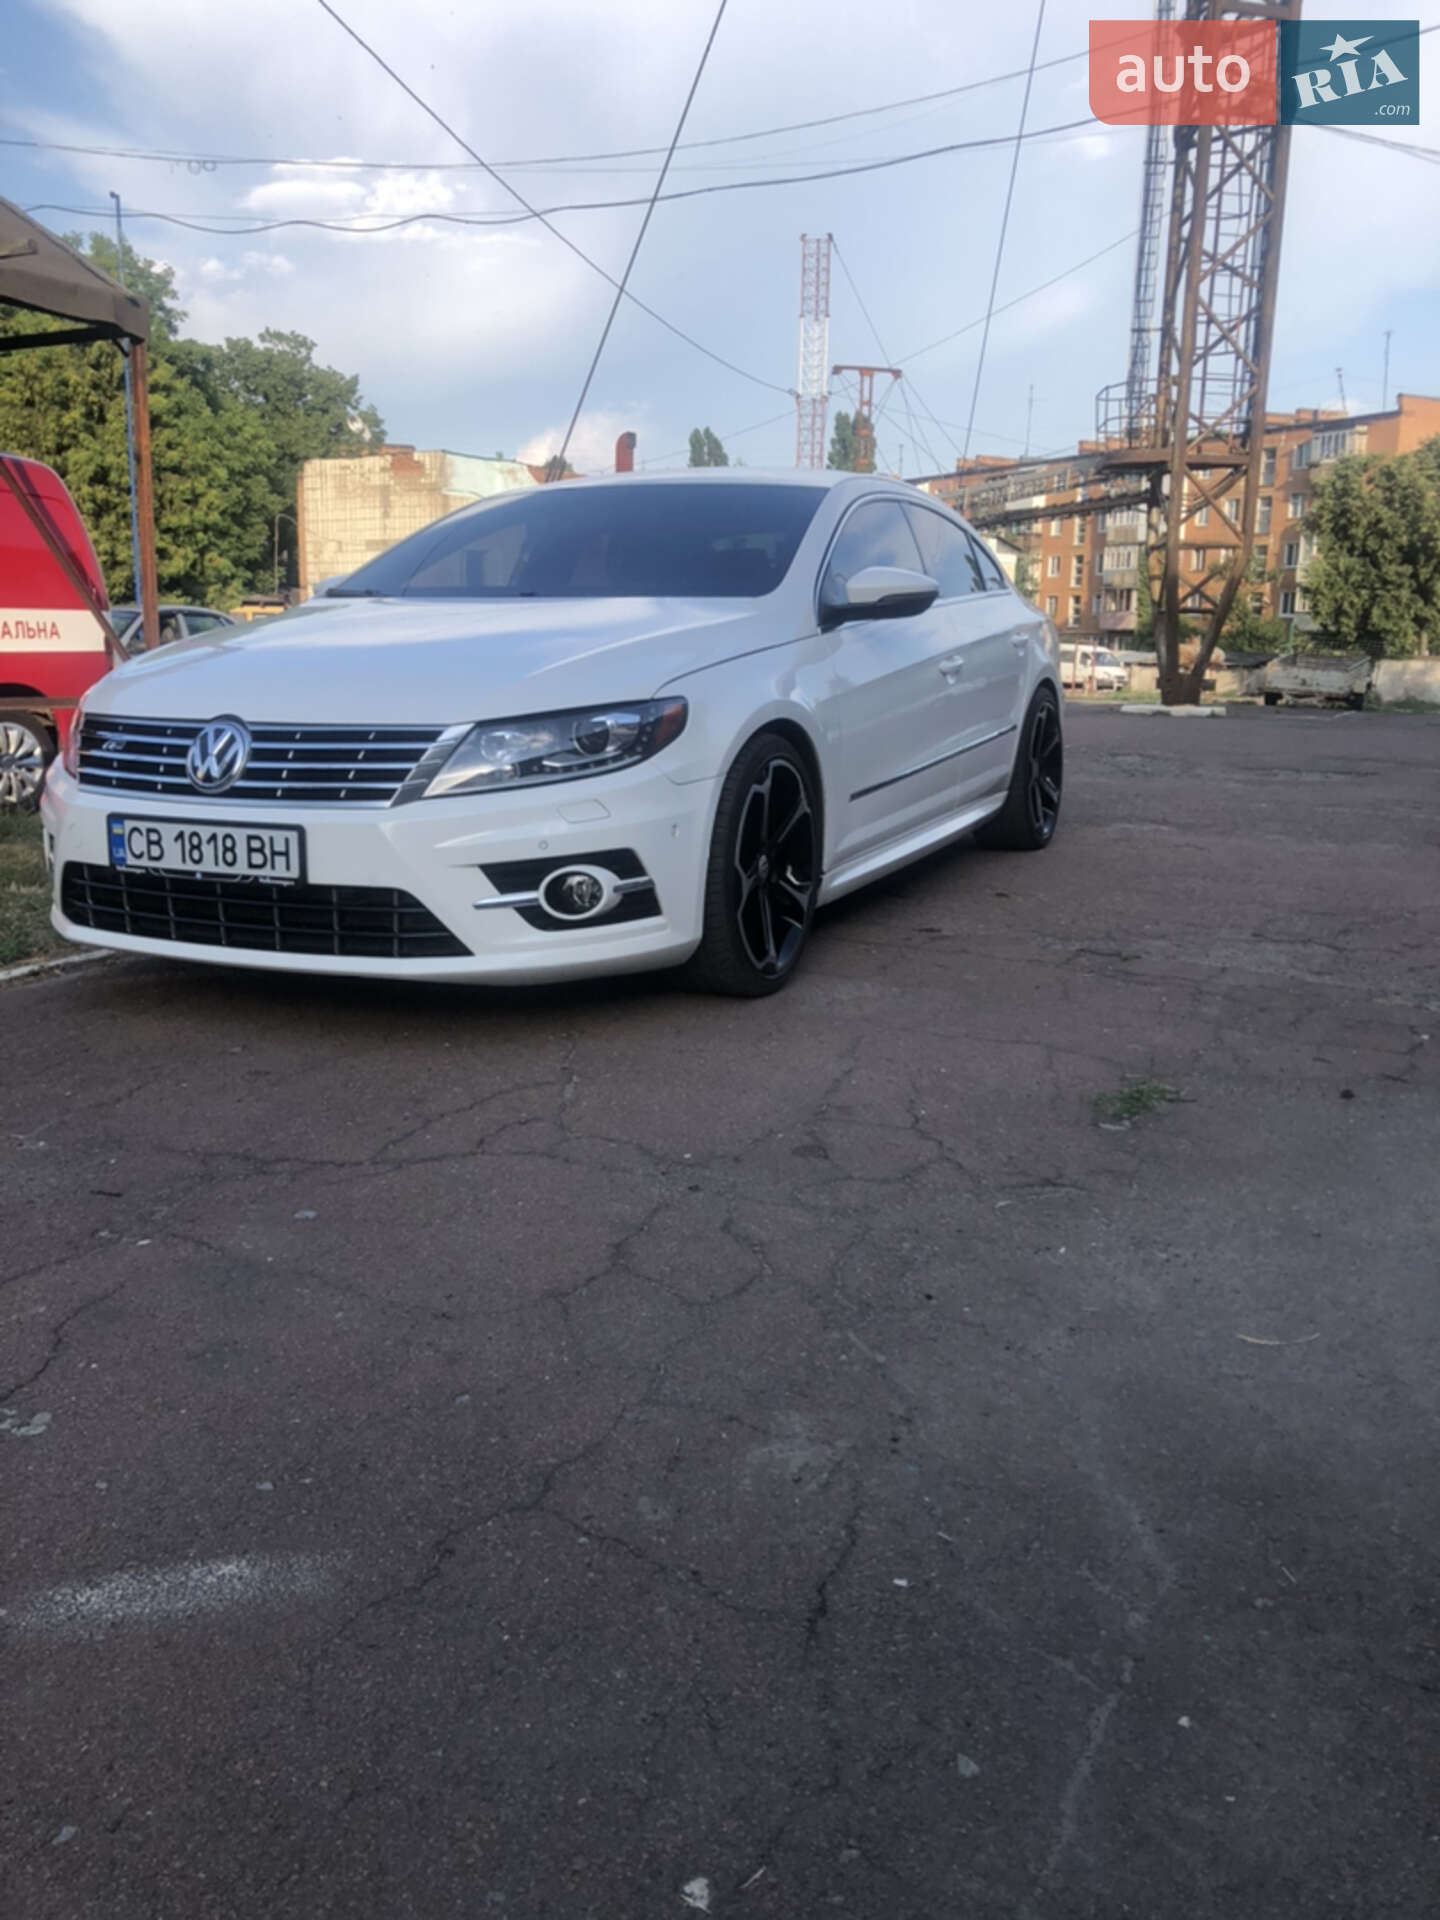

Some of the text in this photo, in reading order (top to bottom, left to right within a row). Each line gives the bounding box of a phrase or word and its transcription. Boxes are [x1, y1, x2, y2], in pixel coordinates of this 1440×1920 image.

[1, 620, 61, 640] АЛЬНА
[127, 826, 291, 872] CB 1818 BH
